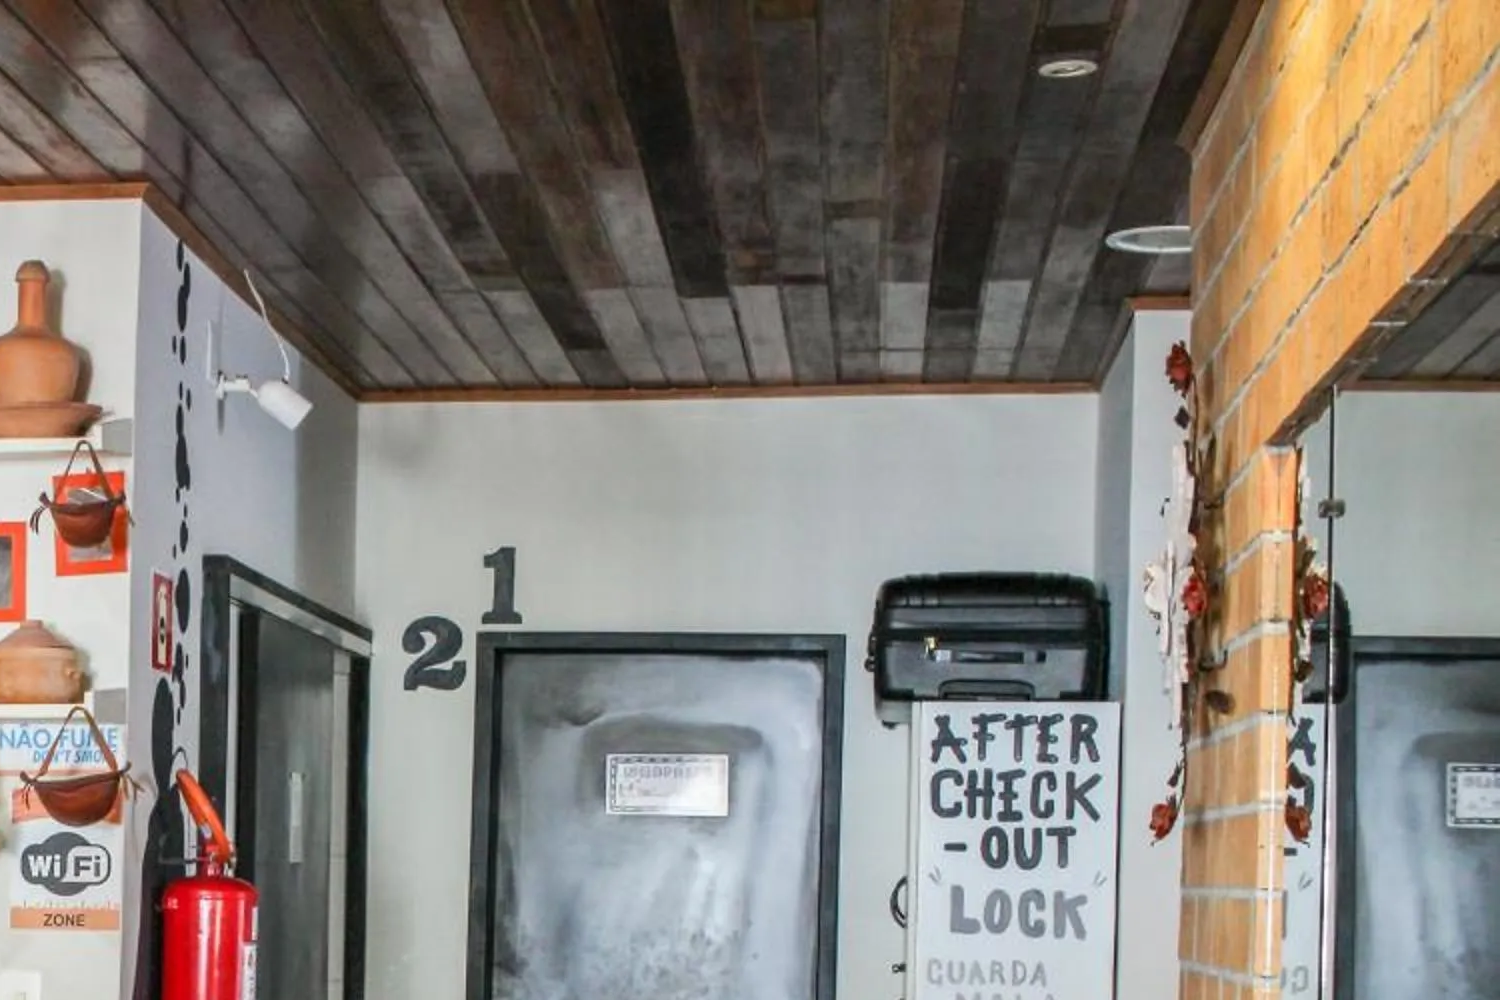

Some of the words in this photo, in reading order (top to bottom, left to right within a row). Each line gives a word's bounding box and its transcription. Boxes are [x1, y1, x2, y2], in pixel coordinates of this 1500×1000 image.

[481, 546, 523, 625] 1
[401, 615, 467, 691] 2
[60, 728, 118, 748] FUE
[930, 713, 1100, 764] AFTER
[930, 768, 1102, 822] CHECK
[43, 913, 85, 927] ZONE
[949, 884, 1088, 941] LOCK
[926, 958, 1047, 987] GUARDA
